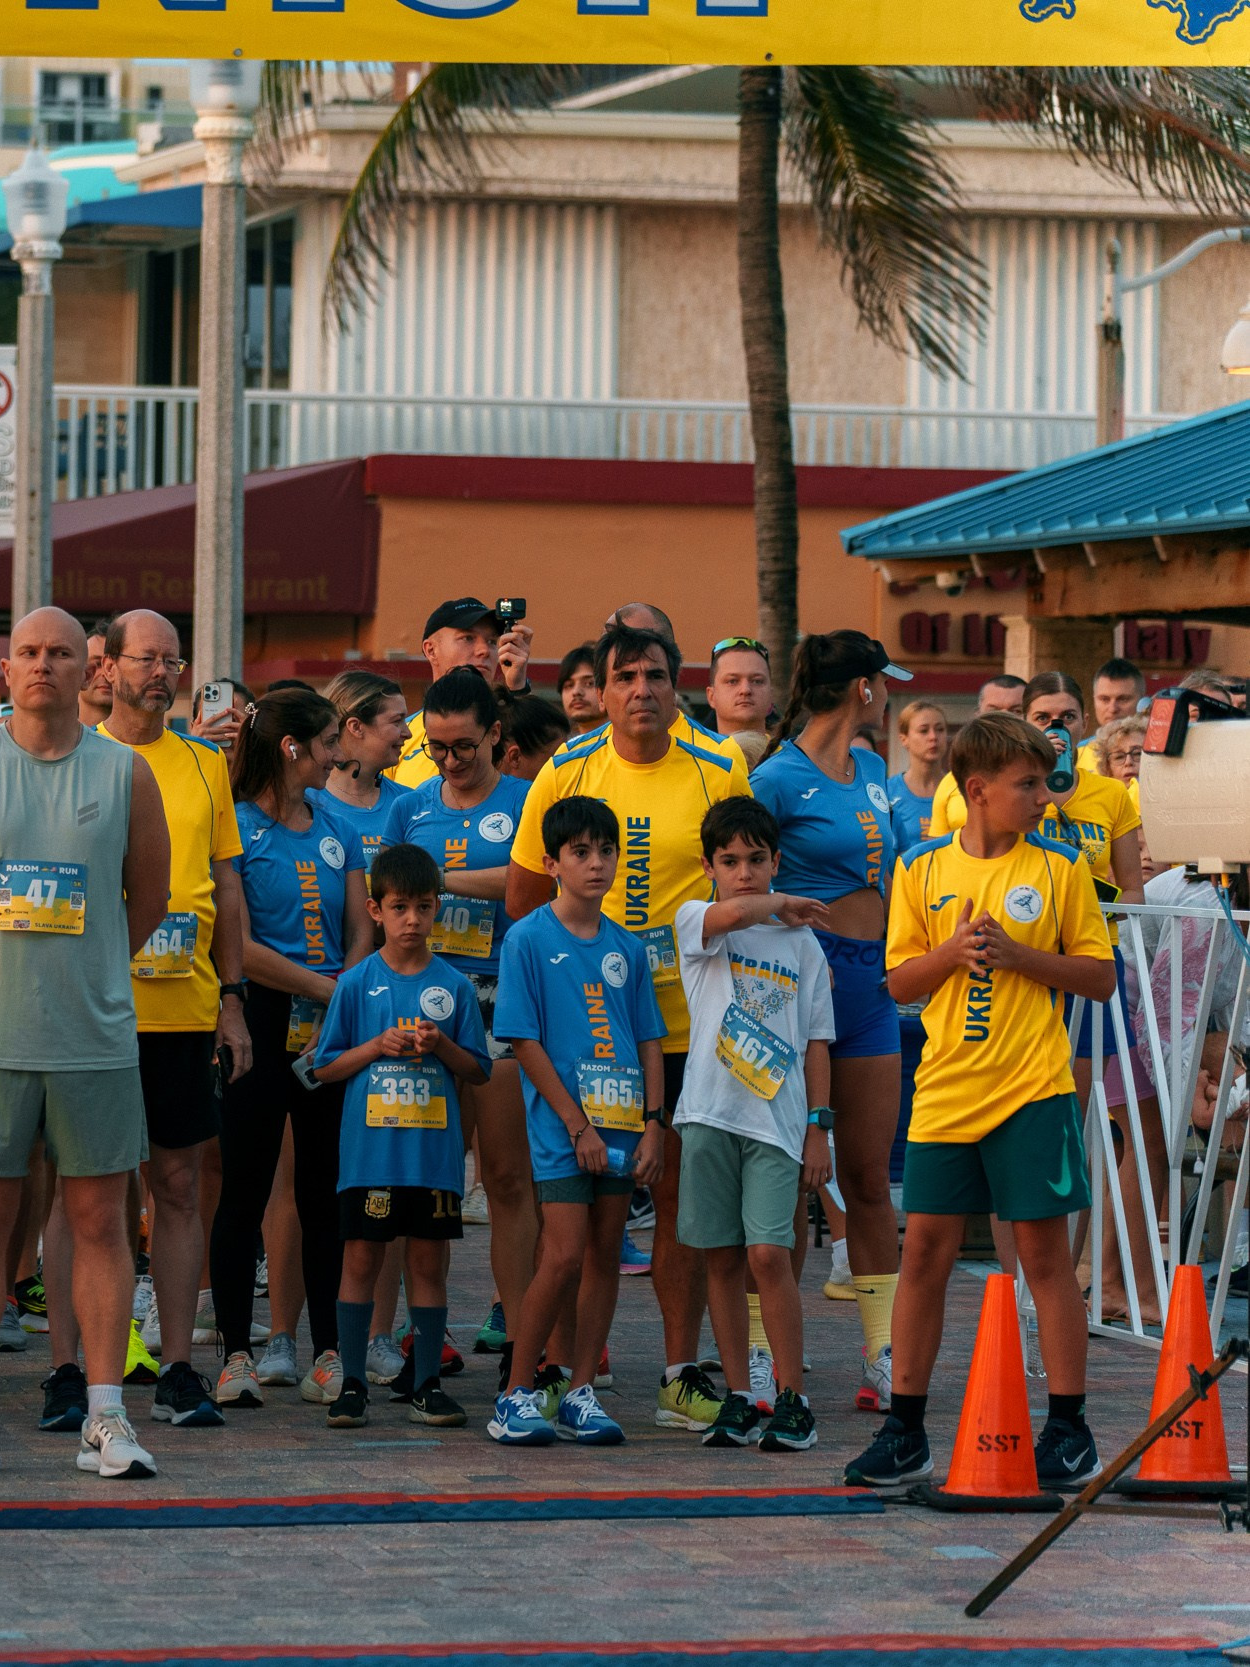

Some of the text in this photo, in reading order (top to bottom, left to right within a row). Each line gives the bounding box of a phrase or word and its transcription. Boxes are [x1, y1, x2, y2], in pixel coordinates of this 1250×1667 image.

[856, 810, 883, 886] RAINE
[6, 864, 78, 875] RAZOM RUN
[625, 816, 650, 926] UKRAINE
[25, 879, 58, 909] 47
[176, 916, 191, 924] RUN
[295, 860, 326, 965] UKRAINE
[441, 906, 470, 934] 40
[649, 930, 665, 939] RUN
[583, 982, 617, 1061] RAINE
[733, 1010, 790, 1055] RAZOM RUN
[733, 1030, 774, 1072] 167
[377, 1065, 406, 1073] RAZOM
[581, 1063, 611, 1073] RAZOM
[381, 1077, 430, 1106] 333
[590, 1077, 633, 1108] 165
[977, 1434, 1021, 1453] SST
